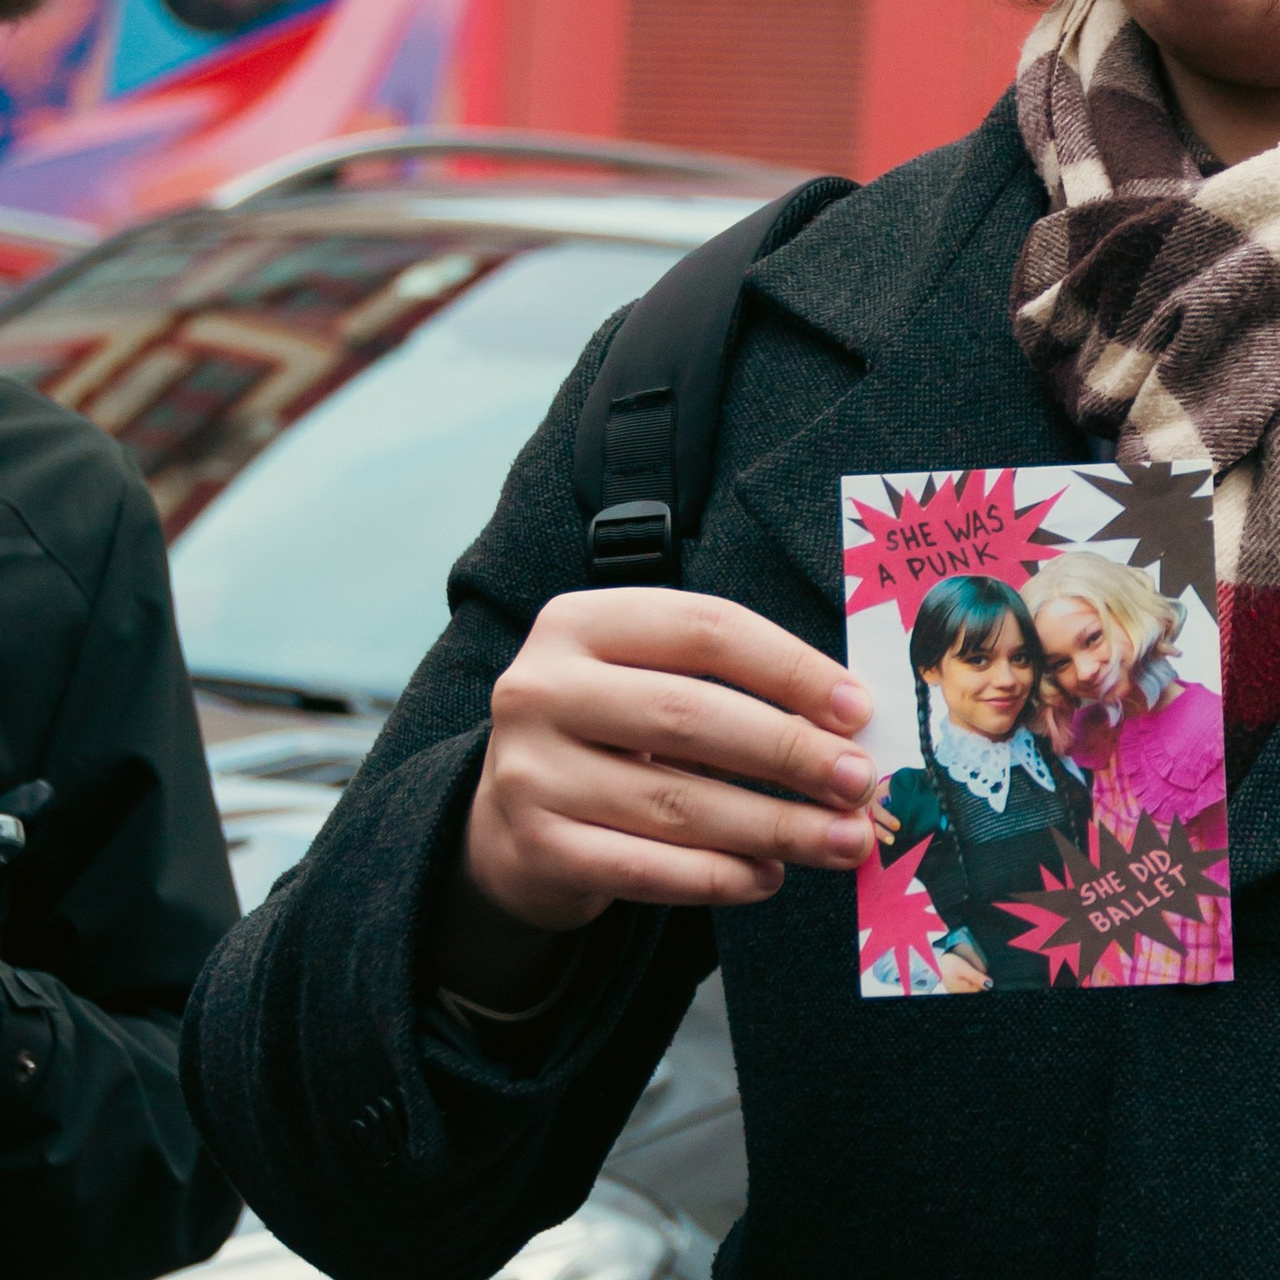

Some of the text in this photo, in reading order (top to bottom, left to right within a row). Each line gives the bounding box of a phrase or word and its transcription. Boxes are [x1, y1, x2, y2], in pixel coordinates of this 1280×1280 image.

[886, 504, 1004, 551] SHE WAS
[878, 542, 999, 588] A PUNK
[1080, 849, 1171, 906] SHE DID
[1088, 864, 1187, 933] BALLET
